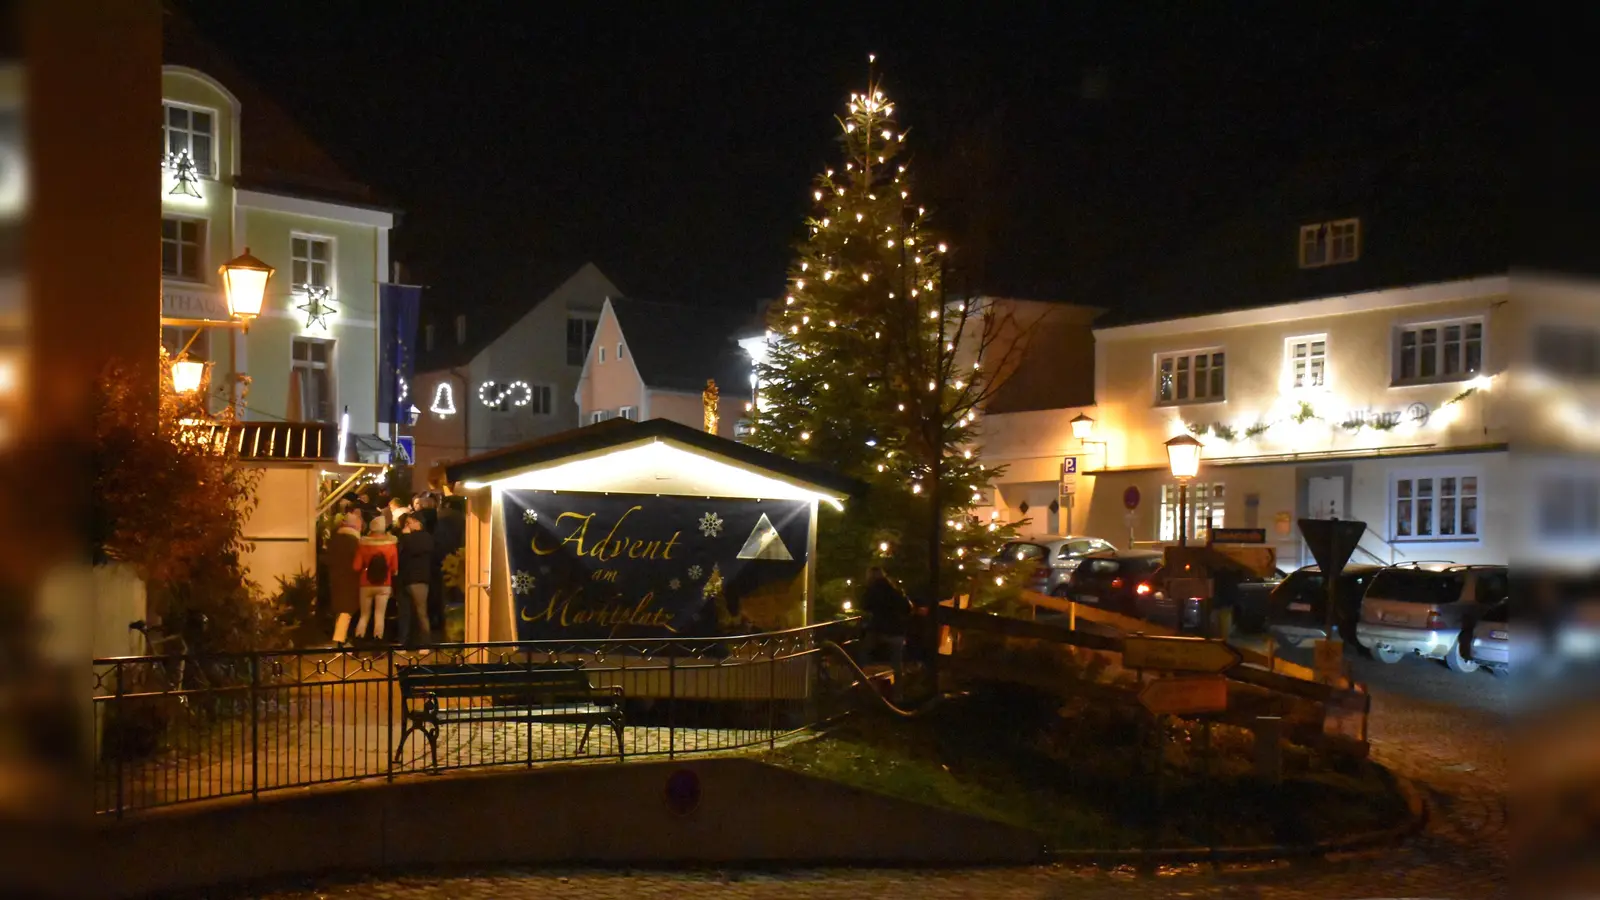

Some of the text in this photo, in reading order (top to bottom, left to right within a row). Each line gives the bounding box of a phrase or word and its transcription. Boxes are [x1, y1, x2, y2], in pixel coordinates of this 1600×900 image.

[1065, 458, 1074, 472] P
[531, 505, 682, 562] Advent
[591, 567, 620, 582] am
[520, 586, 679, 639] Marktplatz
